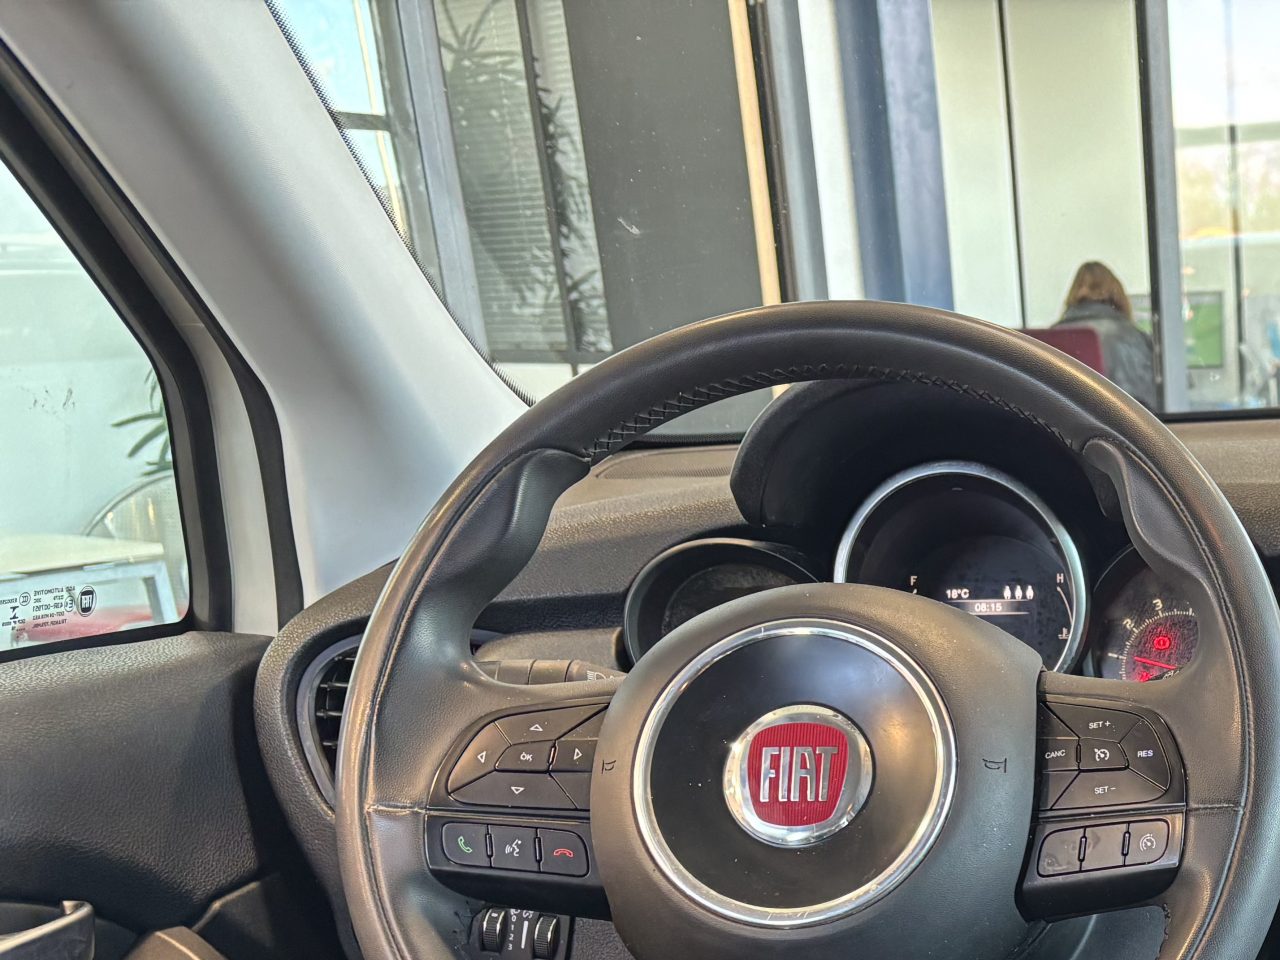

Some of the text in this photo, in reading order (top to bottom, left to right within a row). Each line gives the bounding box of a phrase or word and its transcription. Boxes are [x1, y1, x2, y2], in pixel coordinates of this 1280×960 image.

[910, 575, 918, 587] F
[1056, 573, 1065, 584] H
[1152, 598, 1163, 610] 3
[1122, 618, 1134, 630] 2
[1088, 721, 1103, 729] SET
[520, 752, 533, 762] OK
[1044, 749, 1066, 759] CANC
[1137, 750, 1154, 758] RES
[759, 746, 839, 803] FIAT
[1094, 786, 1108, 794] SET
